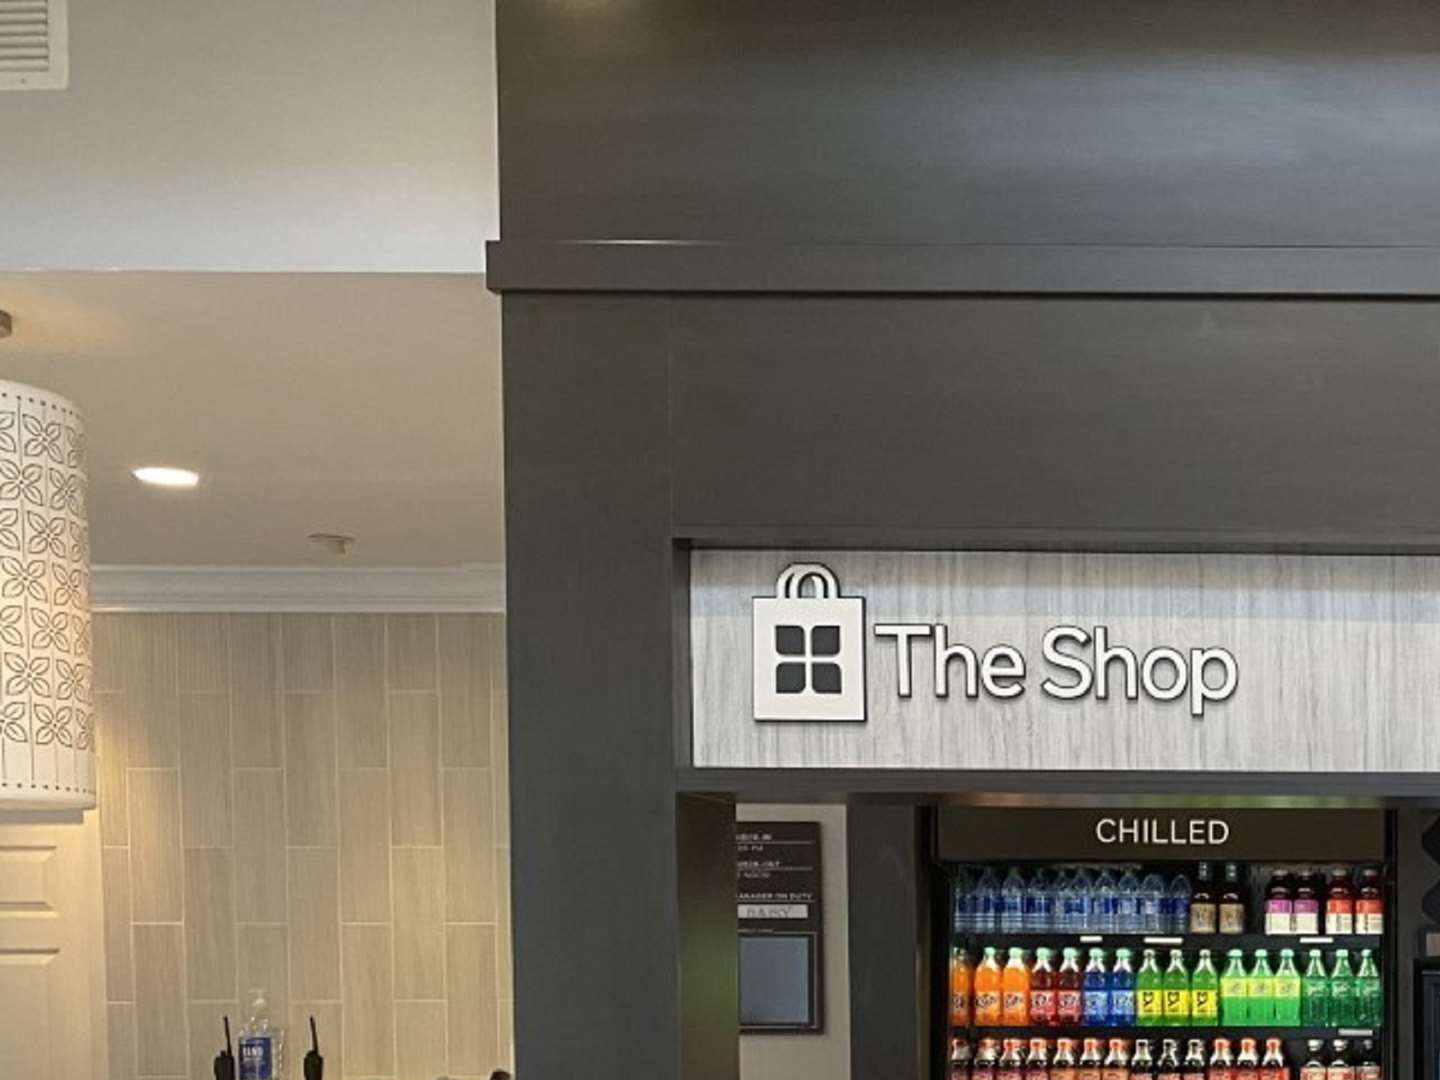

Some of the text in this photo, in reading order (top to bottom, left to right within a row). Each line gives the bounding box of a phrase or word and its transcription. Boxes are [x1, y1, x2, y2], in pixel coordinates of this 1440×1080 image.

[874, 623, 1239, 717] The Shop
[1096, 818, 1230, 844] CHILLED
